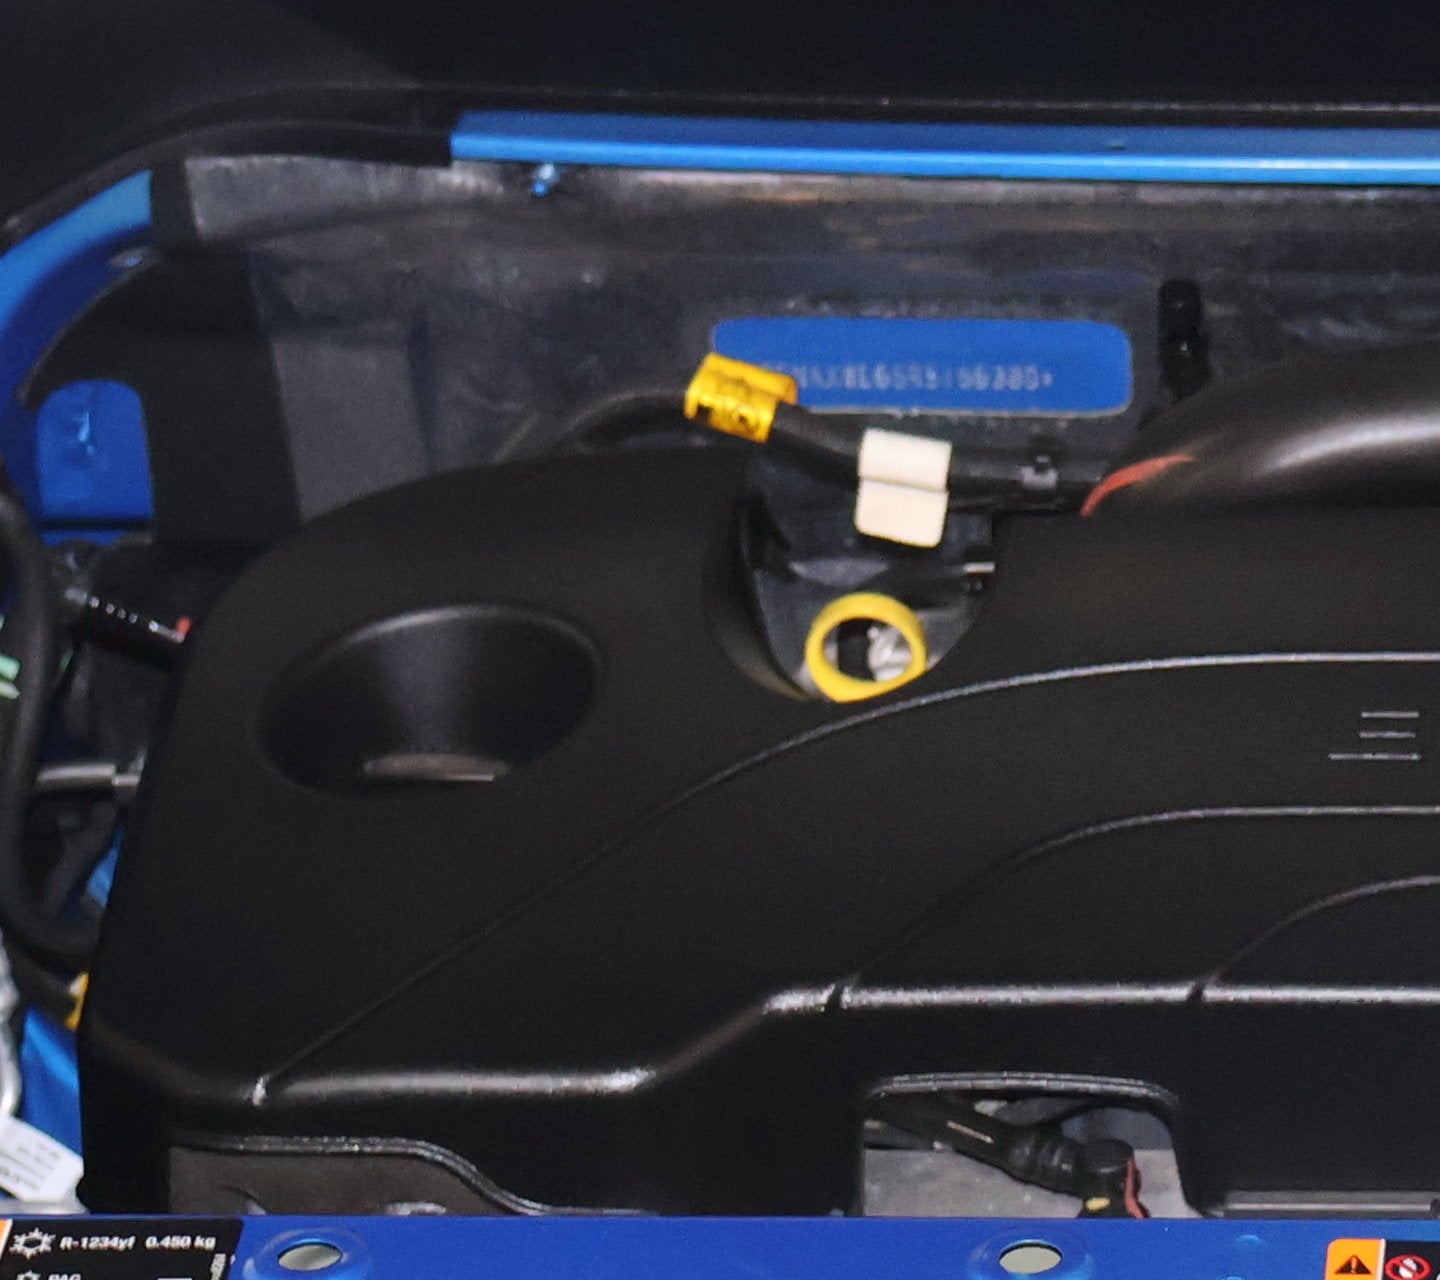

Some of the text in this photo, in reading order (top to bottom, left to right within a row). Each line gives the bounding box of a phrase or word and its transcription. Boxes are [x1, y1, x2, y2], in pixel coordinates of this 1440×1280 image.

[59, 1235, 216, 1253] R-1234yf 0.450 kg
